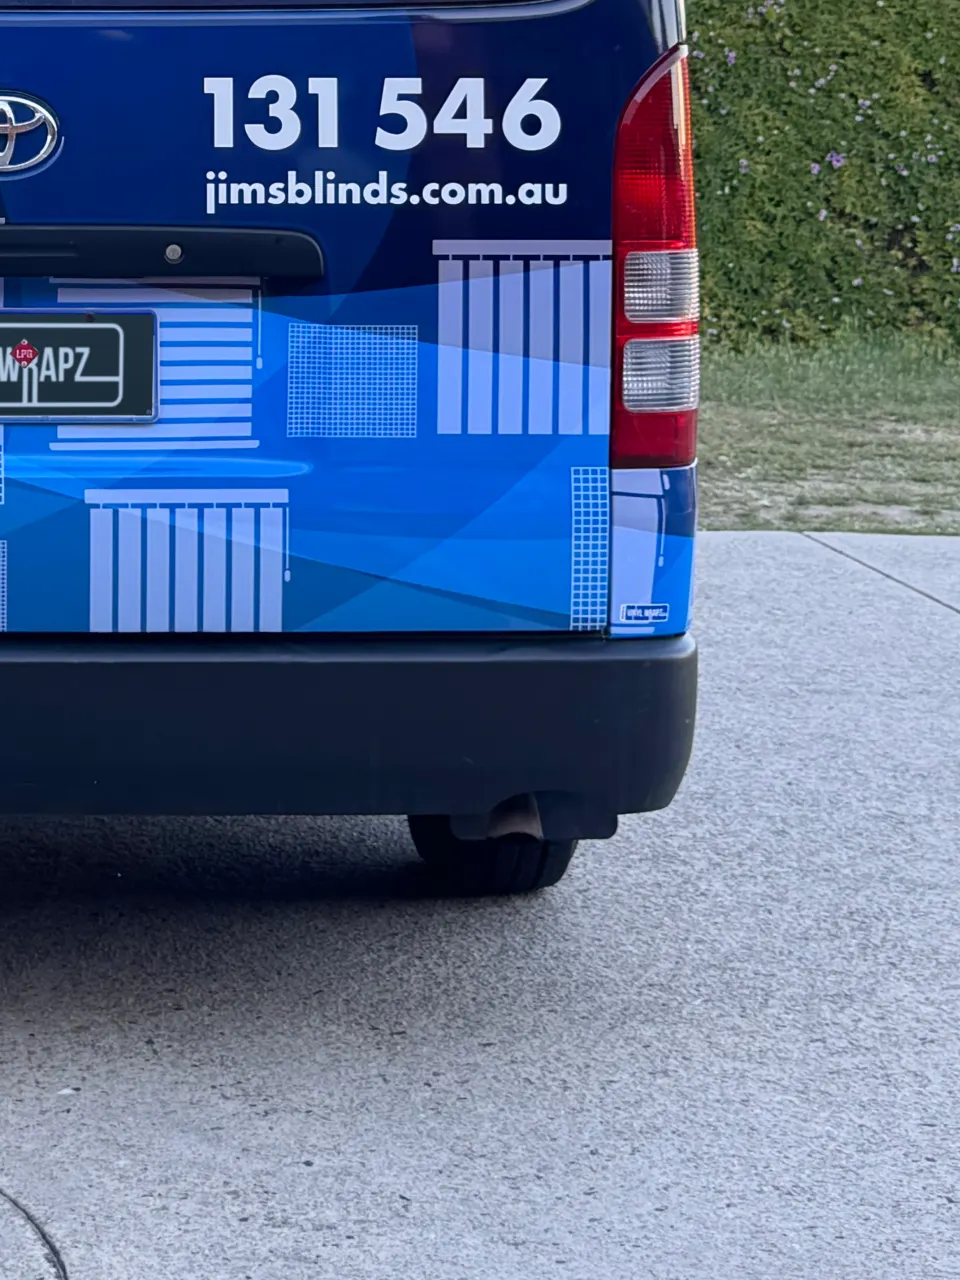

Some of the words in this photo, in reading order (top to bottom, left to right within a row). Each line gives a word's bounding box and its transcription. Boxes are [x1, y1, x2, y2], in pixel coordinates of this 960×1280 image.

[203, 75, 338, 150] 131
[374, 75, 561, 151] 546
[206, 170, 568, 214] jimsblinds.com.au
[15, 349, 33, 359] LPG
